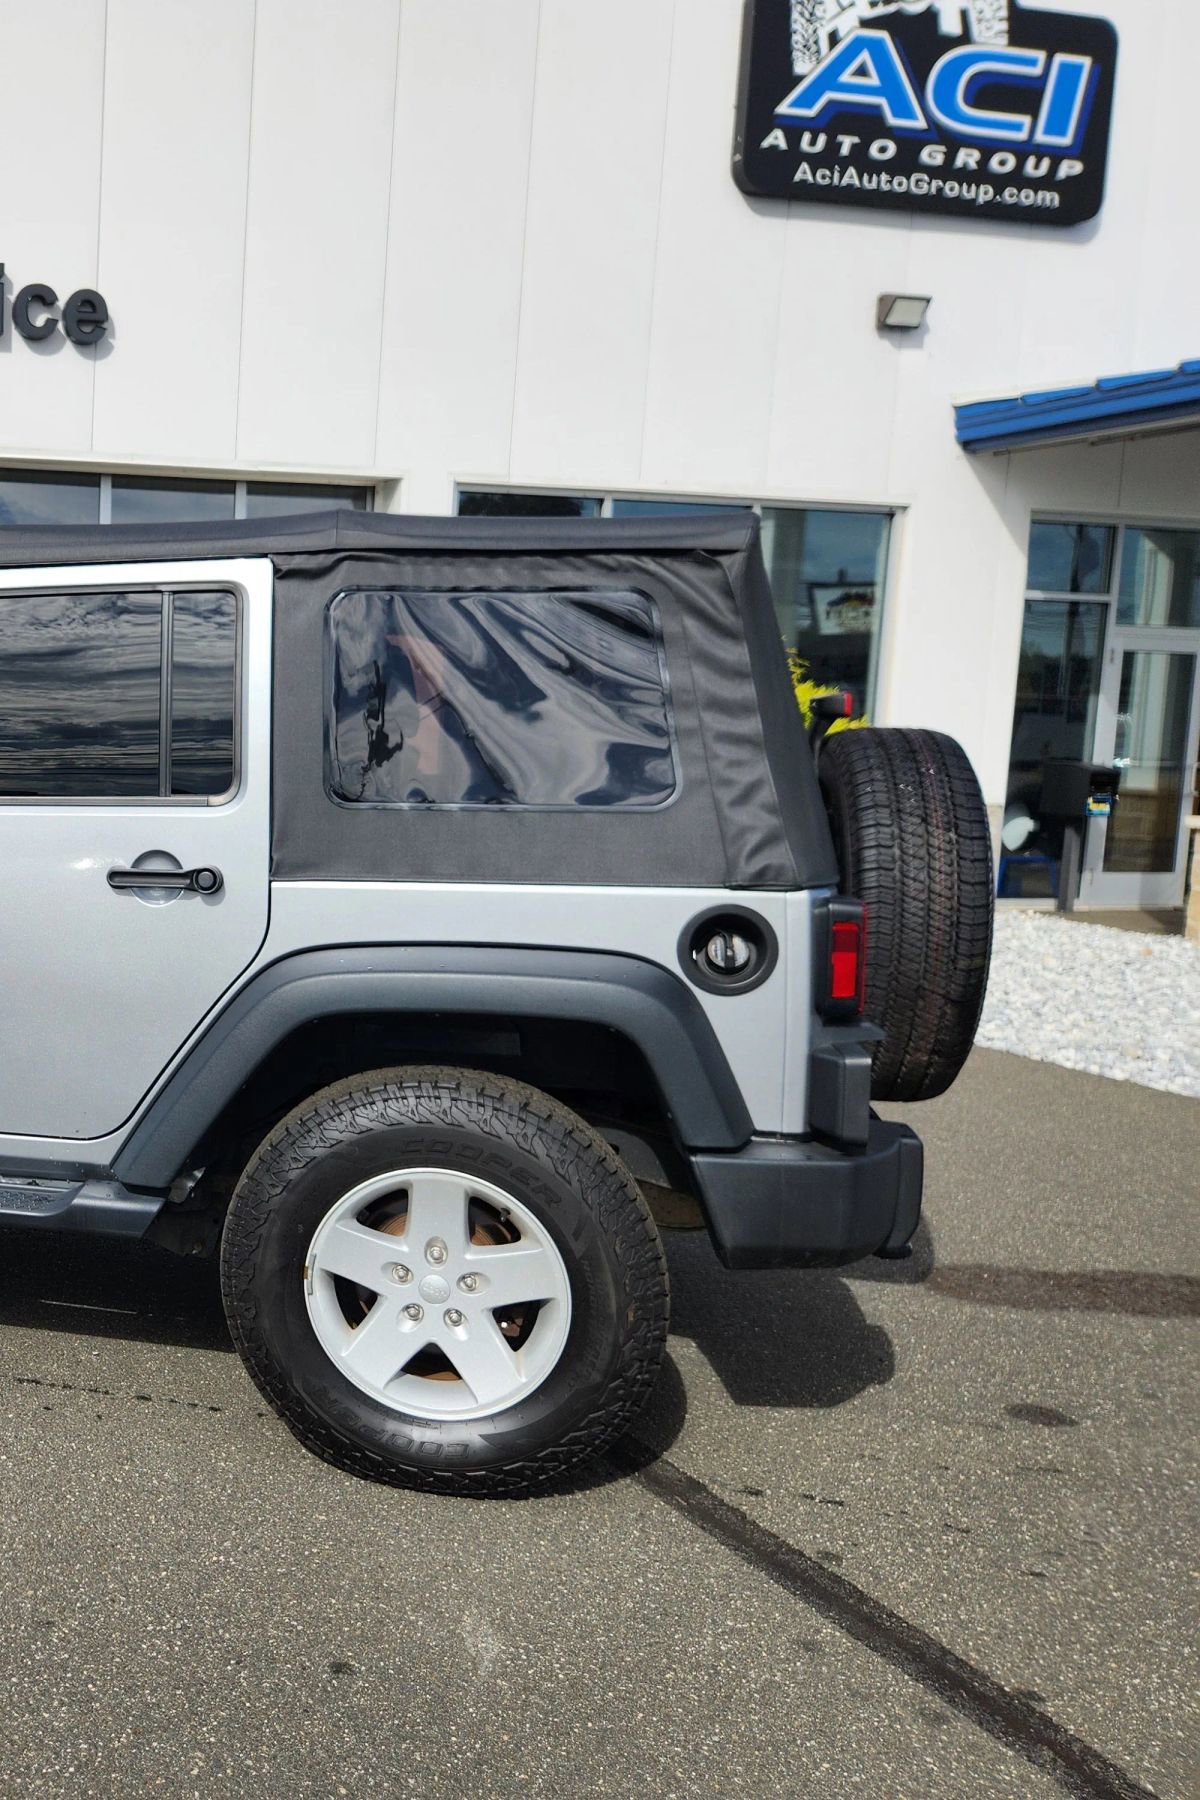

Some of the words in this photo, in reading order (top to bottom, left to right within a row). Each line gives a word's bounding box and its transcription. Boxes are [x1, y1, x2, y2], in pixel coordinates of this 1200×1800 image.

[774, 28, 1094, 148] ACI
[760, 128, 897, 160] AUTO
[918, 144, 1084, 181] GROUP
[793, 161, 1060, 207] AciAutoGroup.com
